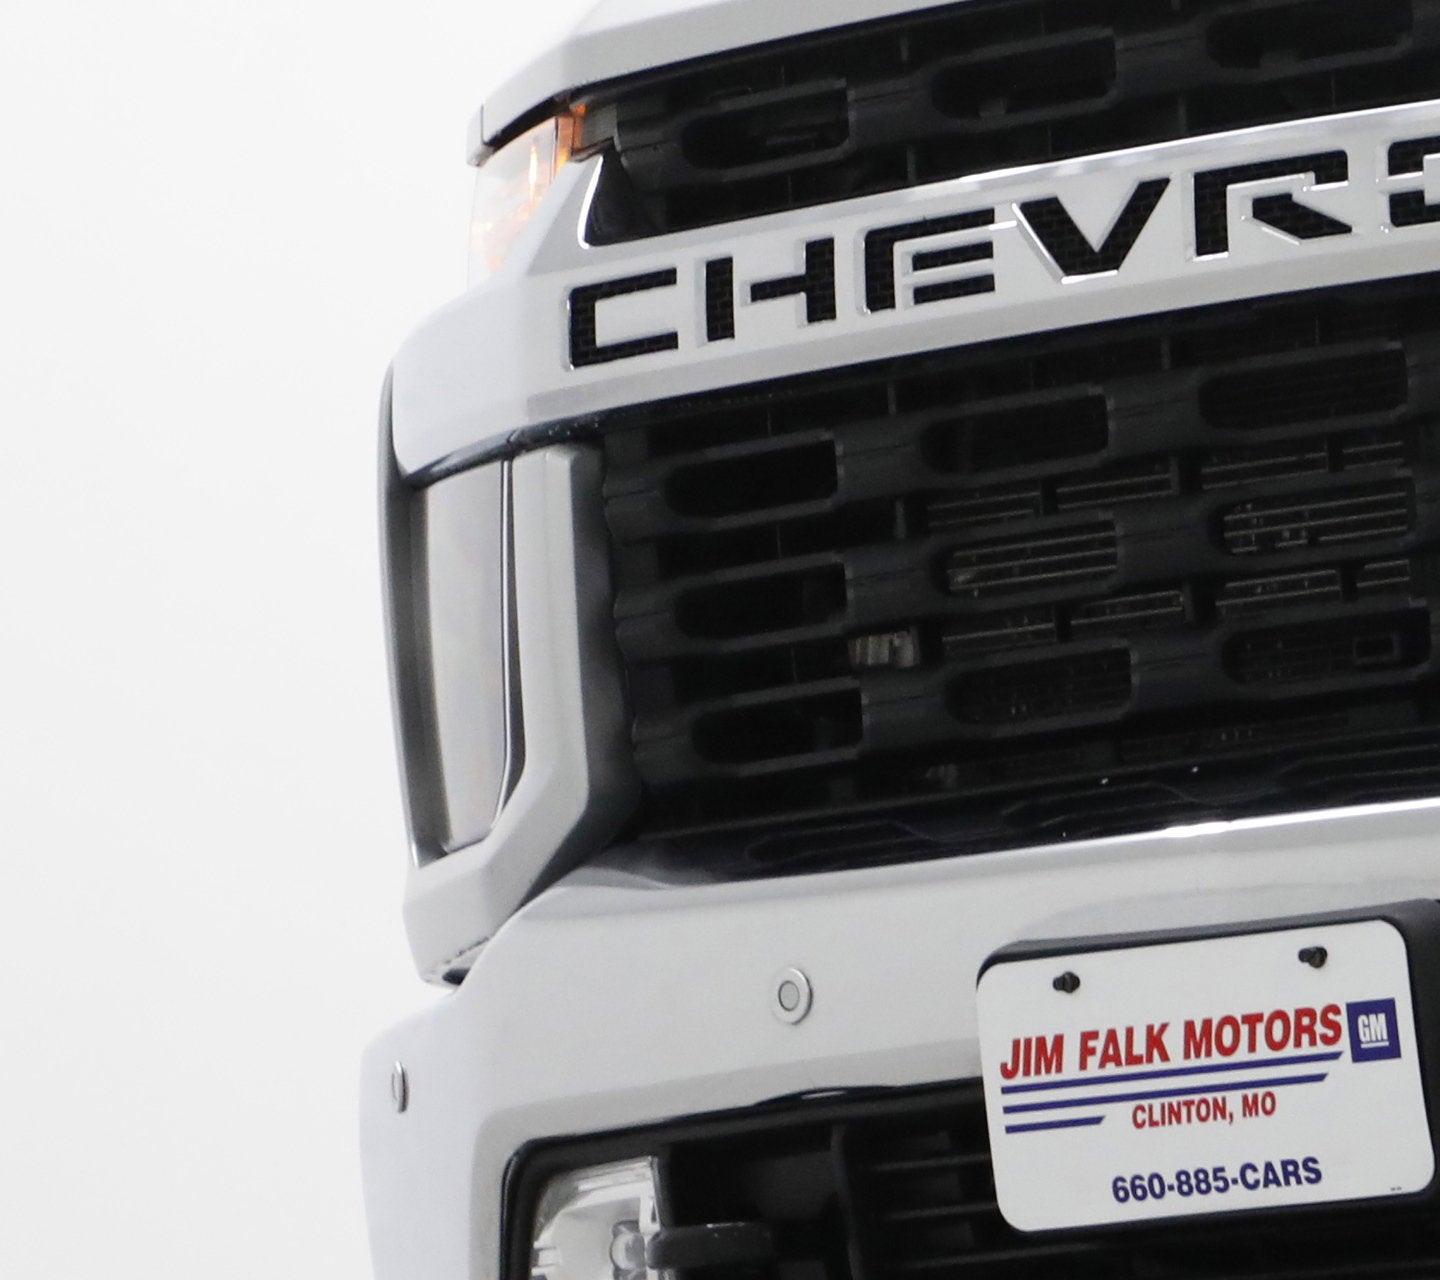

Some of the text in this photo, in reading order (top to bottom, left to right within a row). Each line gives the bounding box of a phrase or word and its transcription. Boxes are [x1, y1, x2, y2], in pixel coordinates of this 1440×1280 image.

[1000, 1003, 1343, 1079] JIM FALK MOTORS
[1357, 1012, 1388, 1044] GM
[1132, 1090, 1277, 1129] CLINTON, MO
[1111, 1156, 1323, 1204] 660-885-CARS
